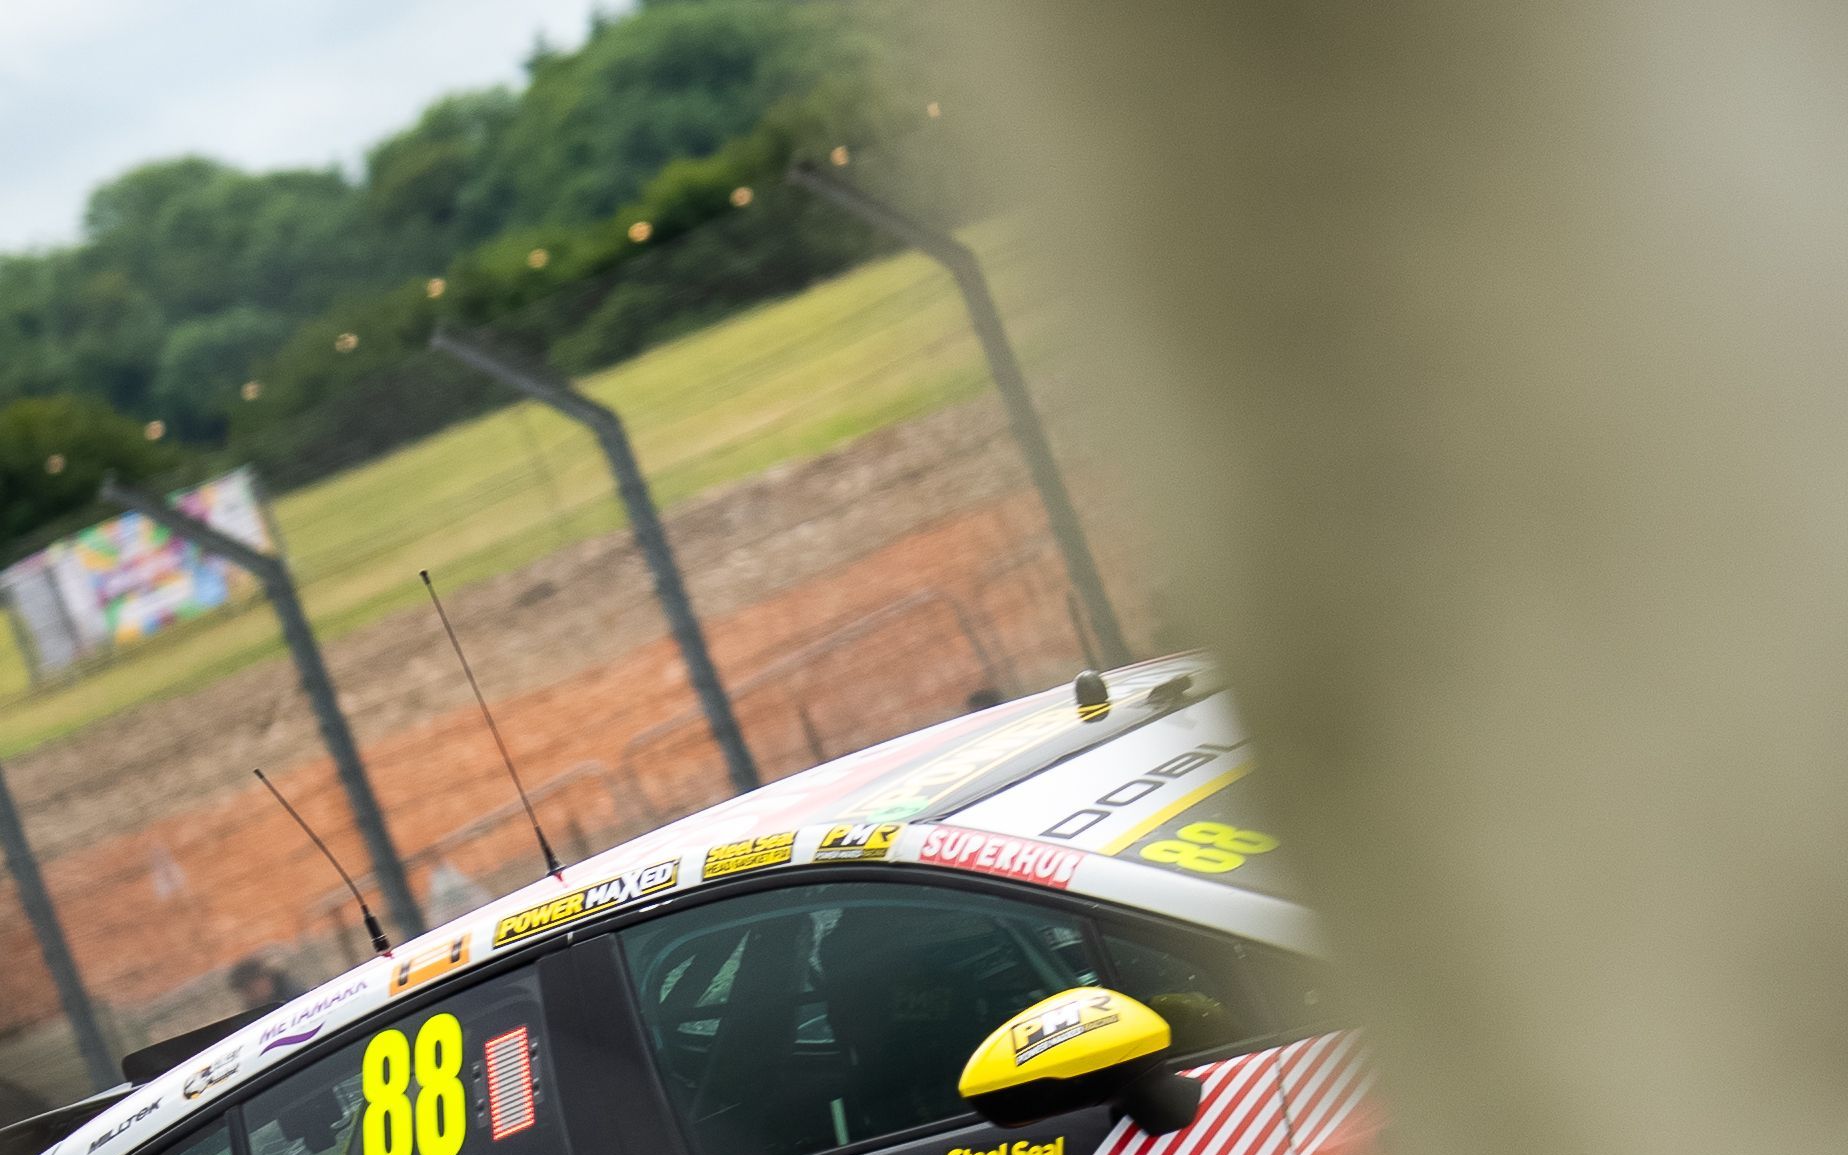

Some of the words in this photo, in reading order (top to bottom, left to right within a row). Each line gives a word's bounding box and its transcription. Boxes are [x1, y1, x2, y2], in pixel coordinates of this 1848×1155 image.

[923, 828, 1078, 884] SUPERHUB
[1140, 821, 1280, 873] 88
[501, 892, 585, 940] POWER
[585, 860, 676, 910] MAXED
